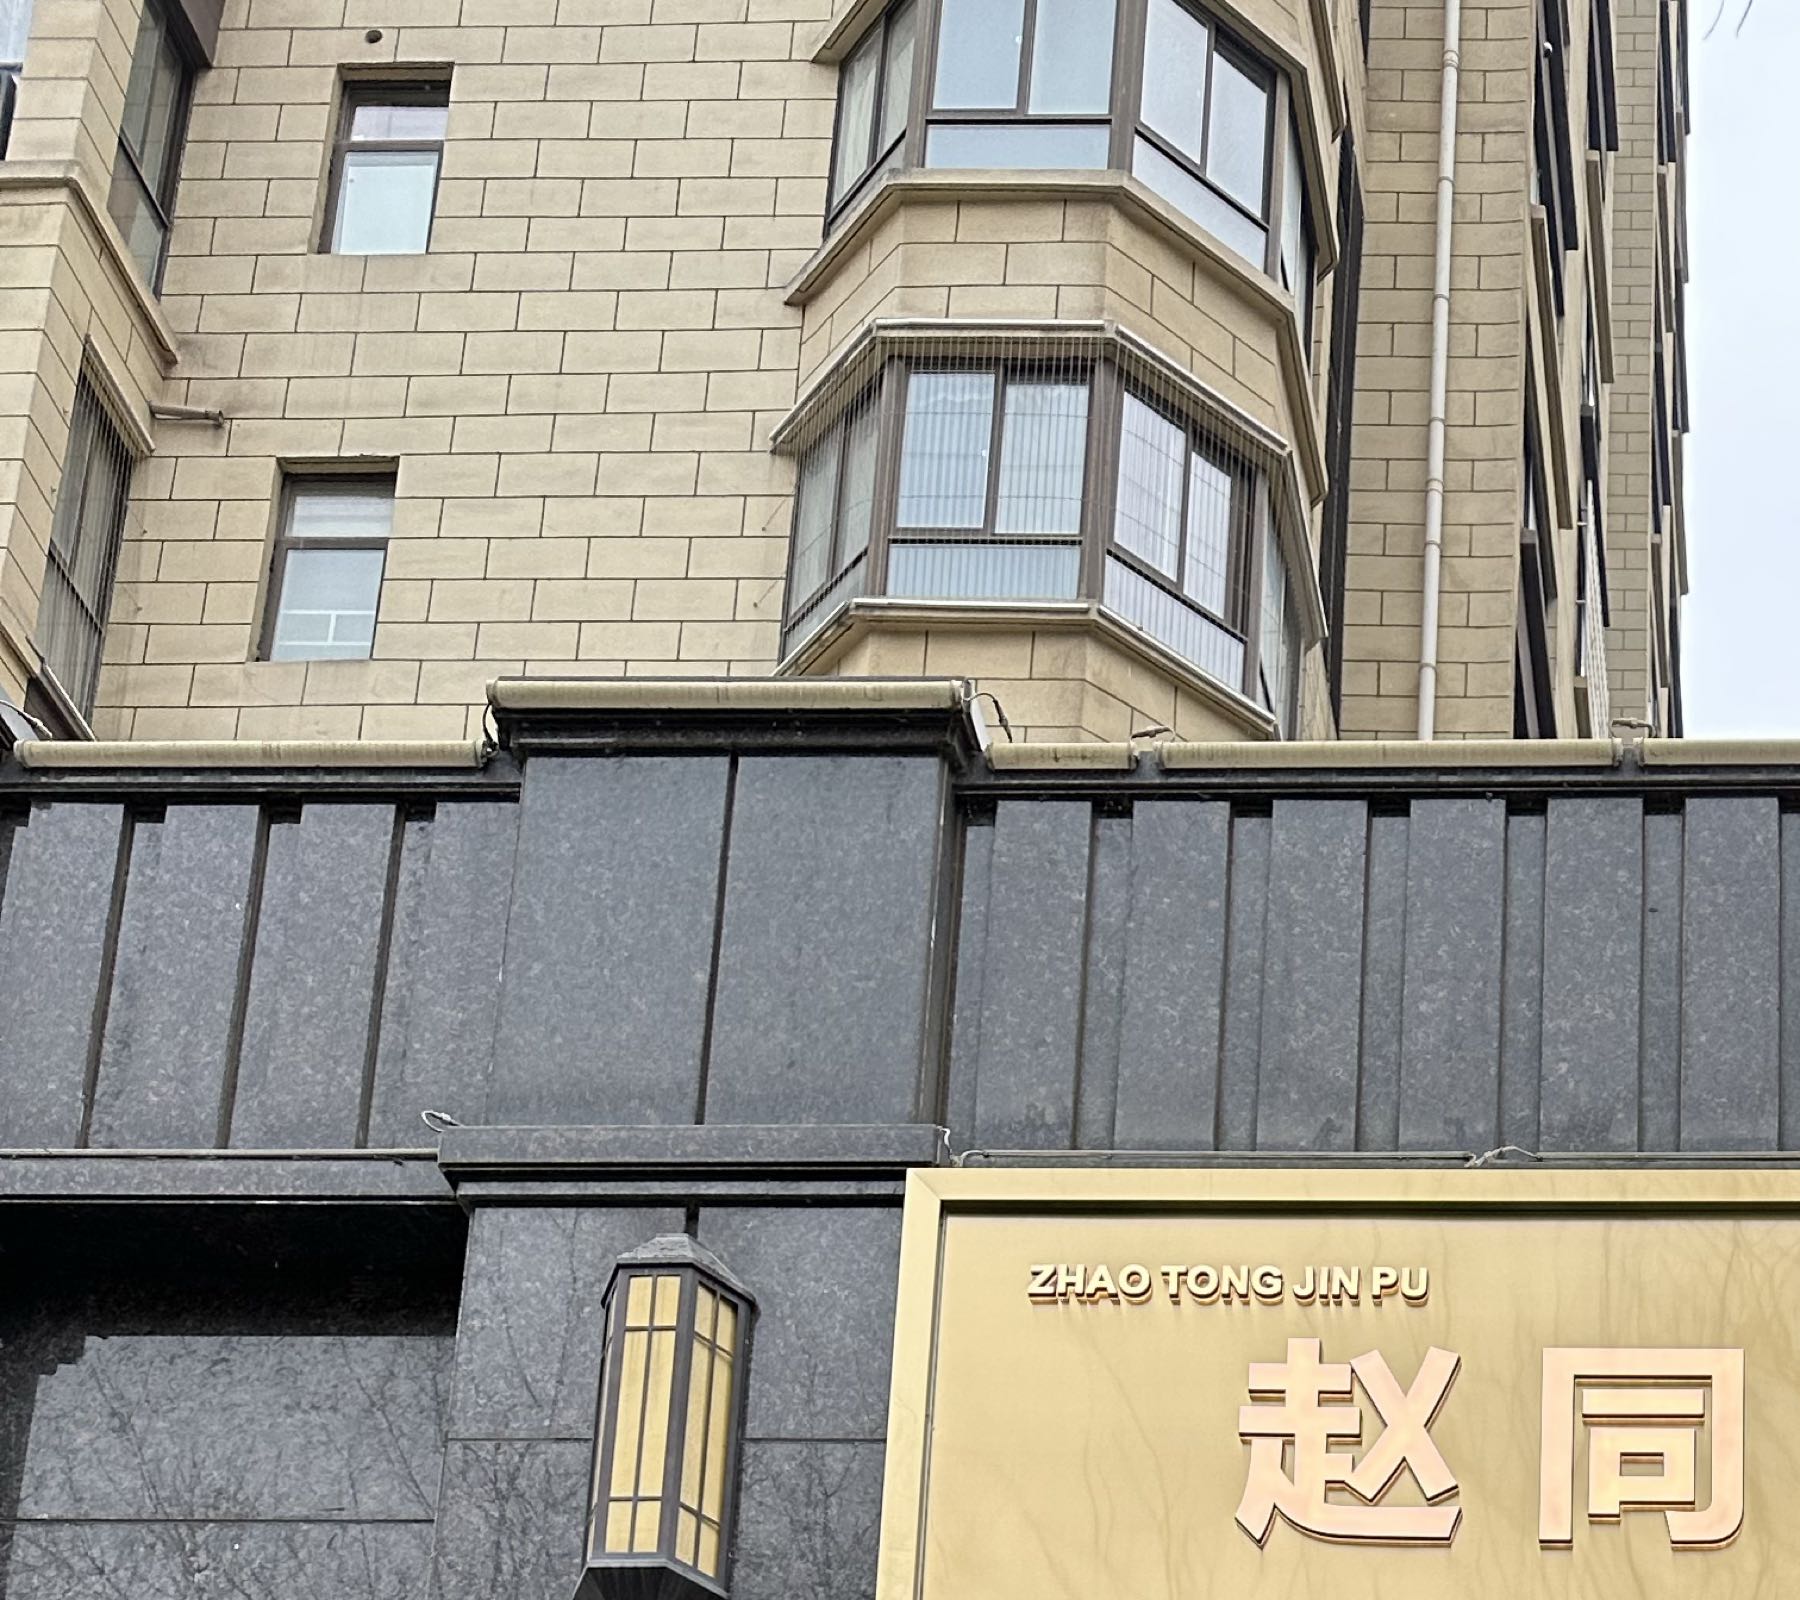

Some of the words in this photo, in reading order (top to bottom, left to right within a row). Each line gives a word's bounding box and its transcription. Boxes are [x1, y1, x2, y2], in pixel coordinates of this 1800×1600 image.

[1028, 1263, 1152, 1303] ZHAO
[1160, 1264, 1285, 1304] TONG
[1293, 1265, 1361, 1305] JIN
[1371, 1266, 1429, 1306] PU
